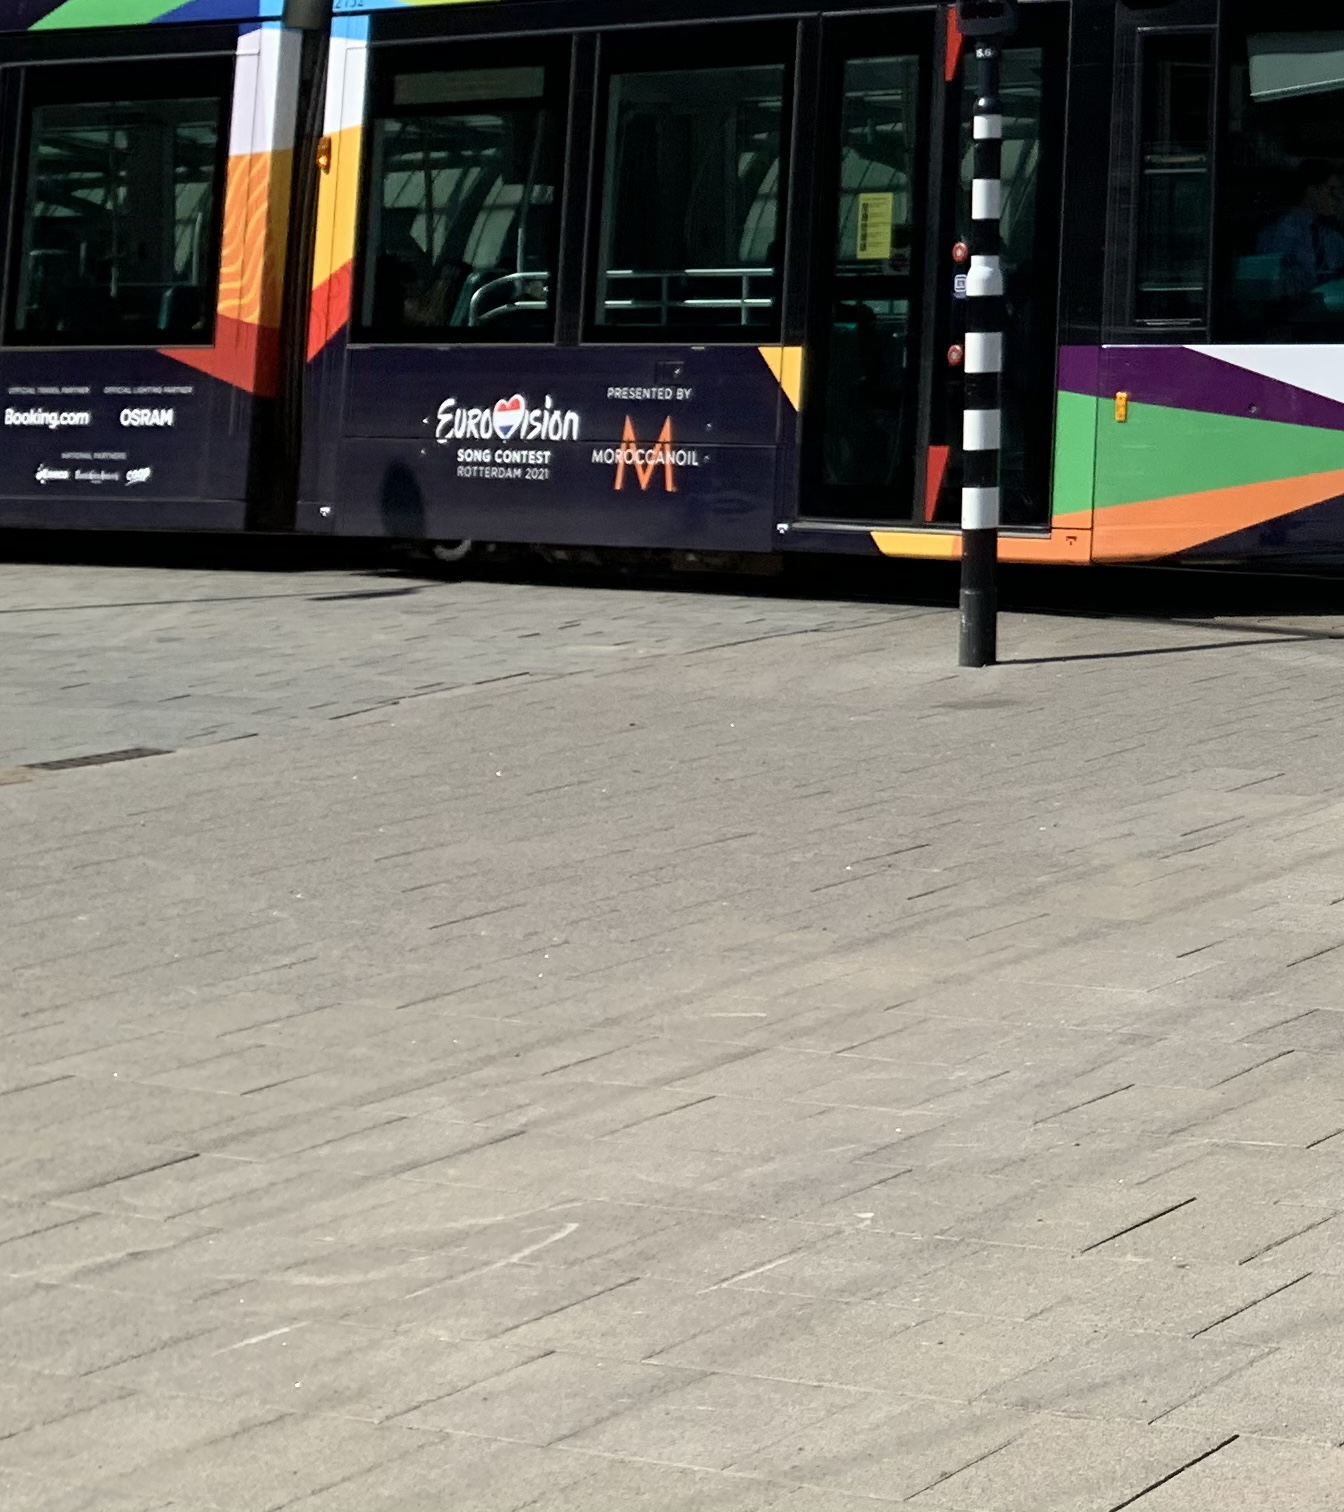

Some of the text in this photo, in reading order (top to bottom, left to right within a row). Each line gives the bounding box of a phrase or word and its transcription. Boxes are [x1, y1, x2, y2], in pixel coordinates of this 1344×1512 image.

[607, 387, 692, 400] PRESENTED BY
[4, 408, 91, 429] Booking.com
[119, 408, 175, 427] OSRAM
[457, 449, 551, 465] SONG CONTEST
[591, 448, 700, 467] MOROCCANOIL
[457, 465, 550, 480] ROTTERDAM 2021
